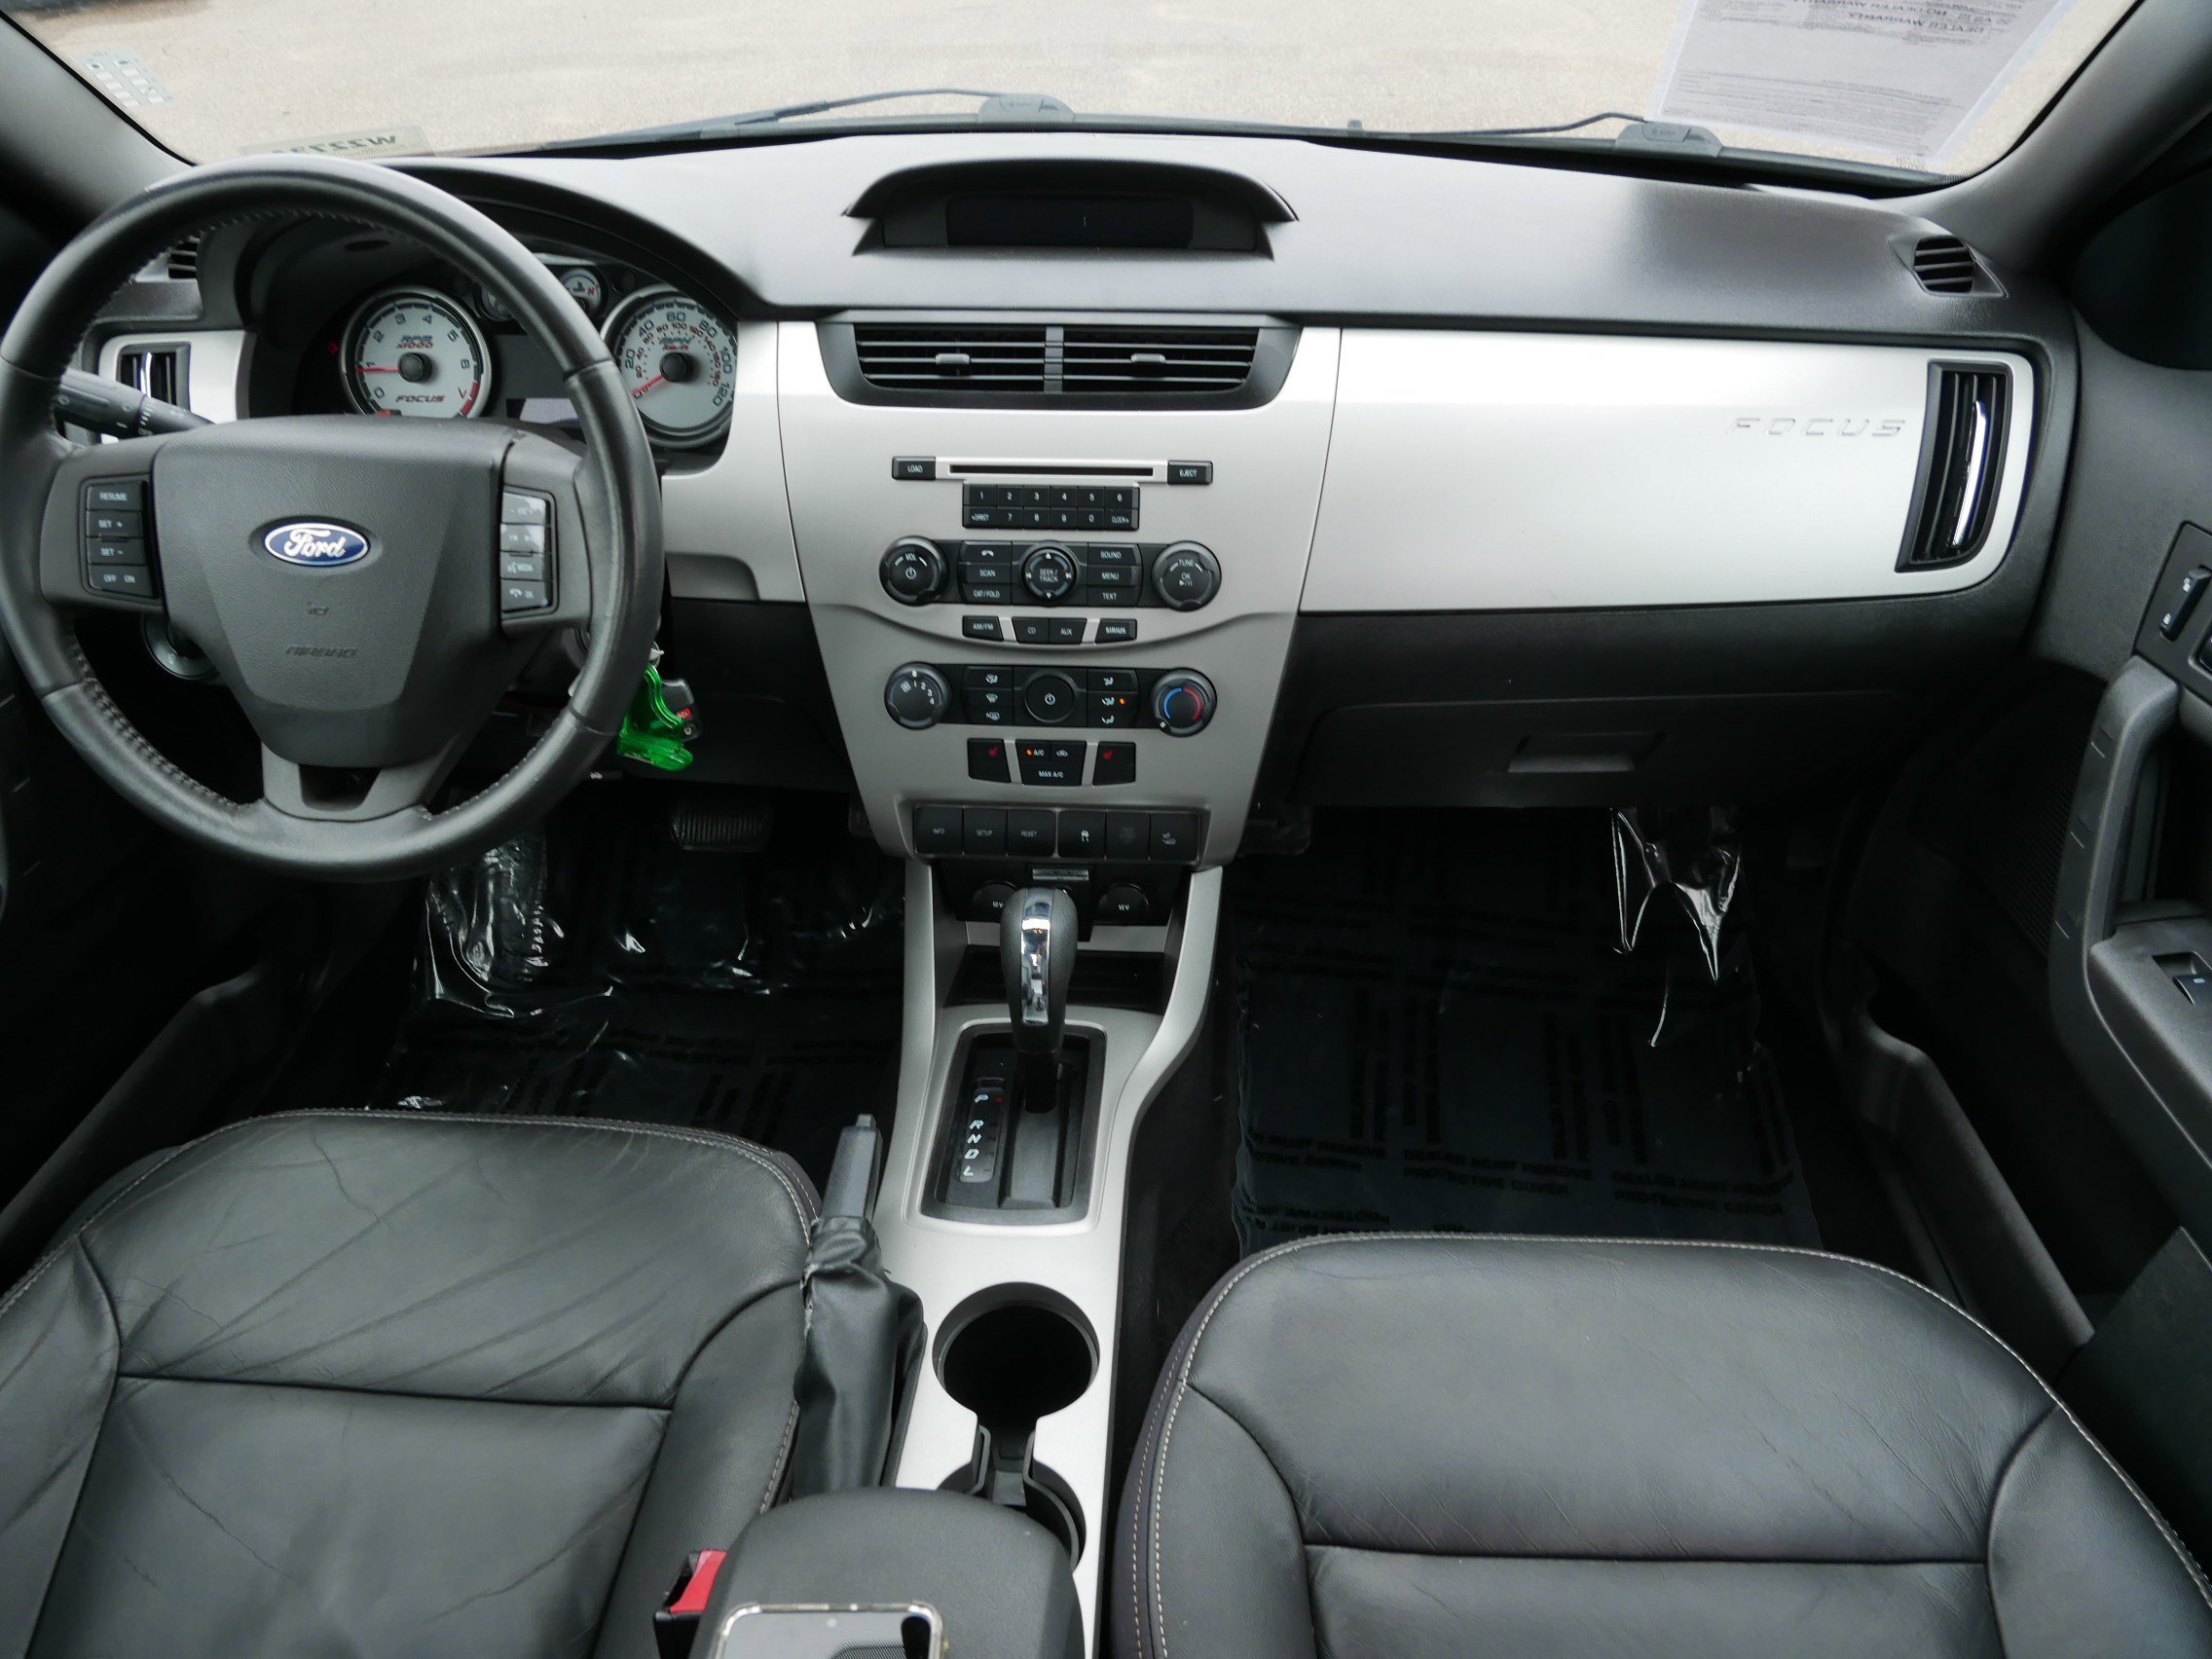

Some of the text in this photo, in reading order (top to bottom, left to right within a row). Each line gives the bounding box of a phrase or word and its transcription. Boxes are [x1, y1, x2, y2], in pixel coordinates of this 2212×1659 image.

[666, 312, 686, 322] 60
[638, 319, 654, 337] 40
[698, 319, 718, 338] 80
[625, 349, 636, 370] 20
[395, 394, 446, 403] FOCUS
[712, 382, 730, 407] 120
[1725, 418, 1905, 437] FOCUS
[1179, 468, 1198, 478] EJECT
[99, 492, 128, 501] RESUME
[98, 520, 112, 529] SET
[283, 529, 347, 558] Ford
[905, 553, 917, 563] VOL
[1100, 551, 1122, 560] SOUND
[1178, 558, 1194, 567] TUNE
[979, 569, 996, 577] SCAN
[1102, 571, 1120, 580] MENU
[124, 574, 135, 584] ON
[1102, 592, 1118, 601] TEXT
[973, 622, 994, 632] AM/FM
[1105, 626, 1126, 635] SIRIUS
[1039, 769, 1064, 779] MAX A/C
[969, 1120, 984, 1129] R
[967, 1133, 982, 1144] N
[964, 1148, 979, 1160] D
[963, 1165, 975, 1176] L
